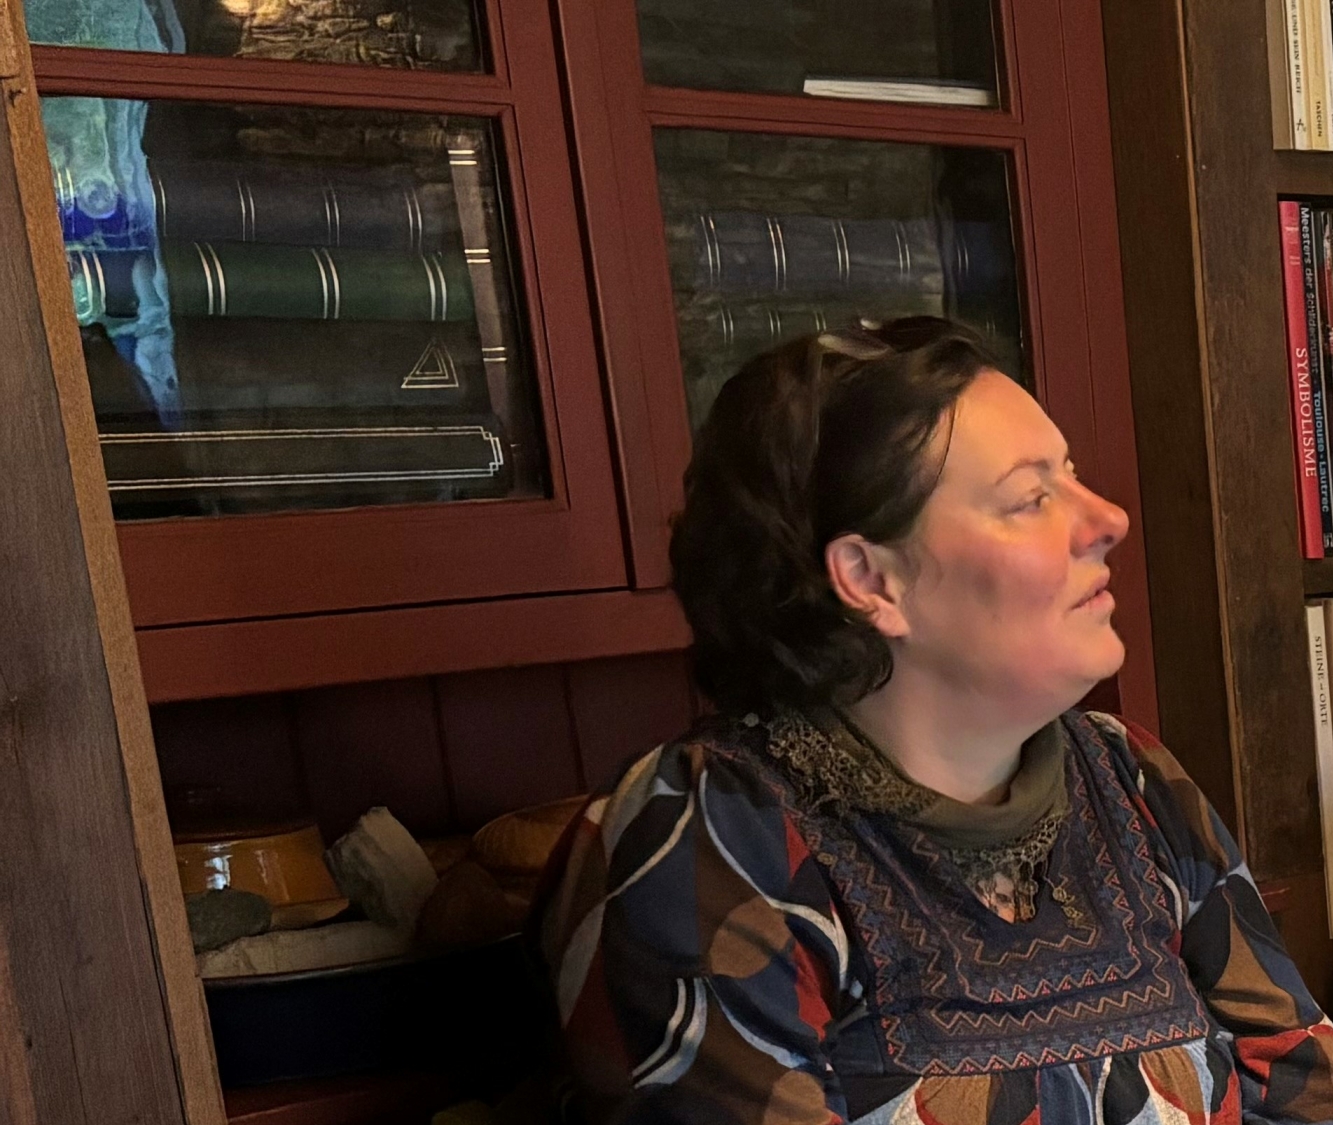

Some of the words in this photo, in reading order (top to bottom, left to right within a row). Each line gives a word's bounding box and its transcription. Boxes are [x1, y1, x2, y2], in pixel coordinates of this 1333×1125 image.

[1300, 207, 1312, 264] Meesters
[1305, 268, 1317, 289] der
[1295, 347, 1317, 478] SYMBOLISME
[1314, 636, 1325, 681] STEINE
[1318, 692, 1328, 727] ORTE
